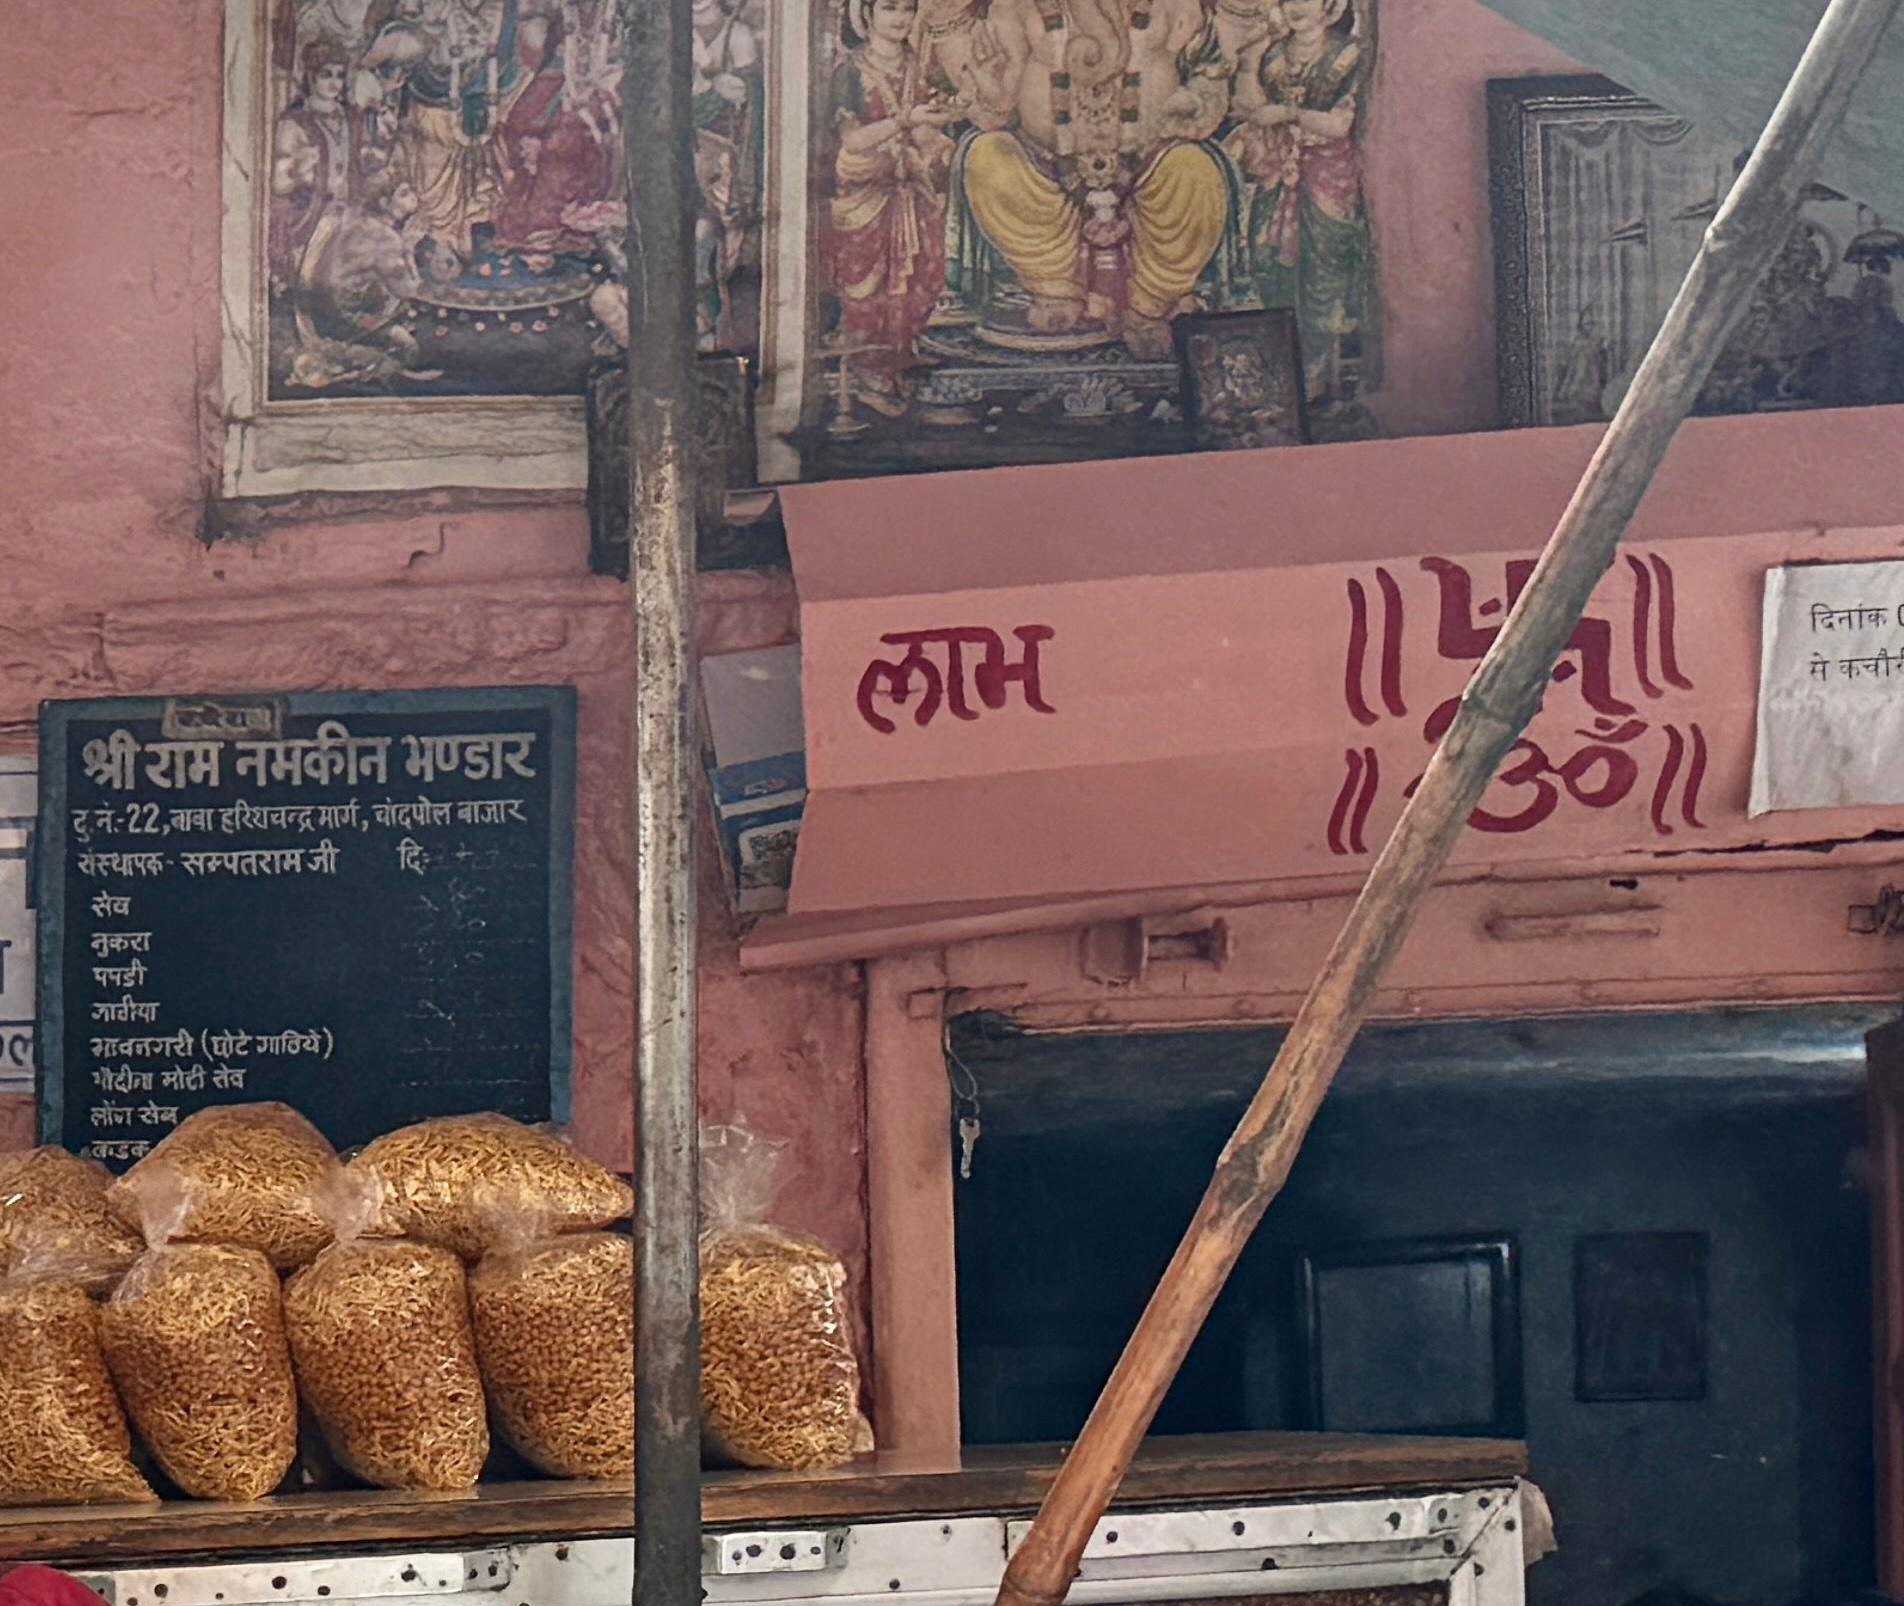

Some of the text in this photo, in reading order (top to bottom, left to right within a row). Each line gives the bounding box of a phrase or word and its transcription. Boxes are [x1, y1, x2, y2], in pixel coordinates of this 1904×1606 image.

[1810, 602, 1889, 634] दिनांक
[857, 624, 1057, 735] लाभ
[82, 720, 536, 791] श्री राम नमकीन भण्डार
[457, 799, 527, 824] बाजार
[306, 837, 340, 874] जी
[91, 890, 132, 918] सेव
